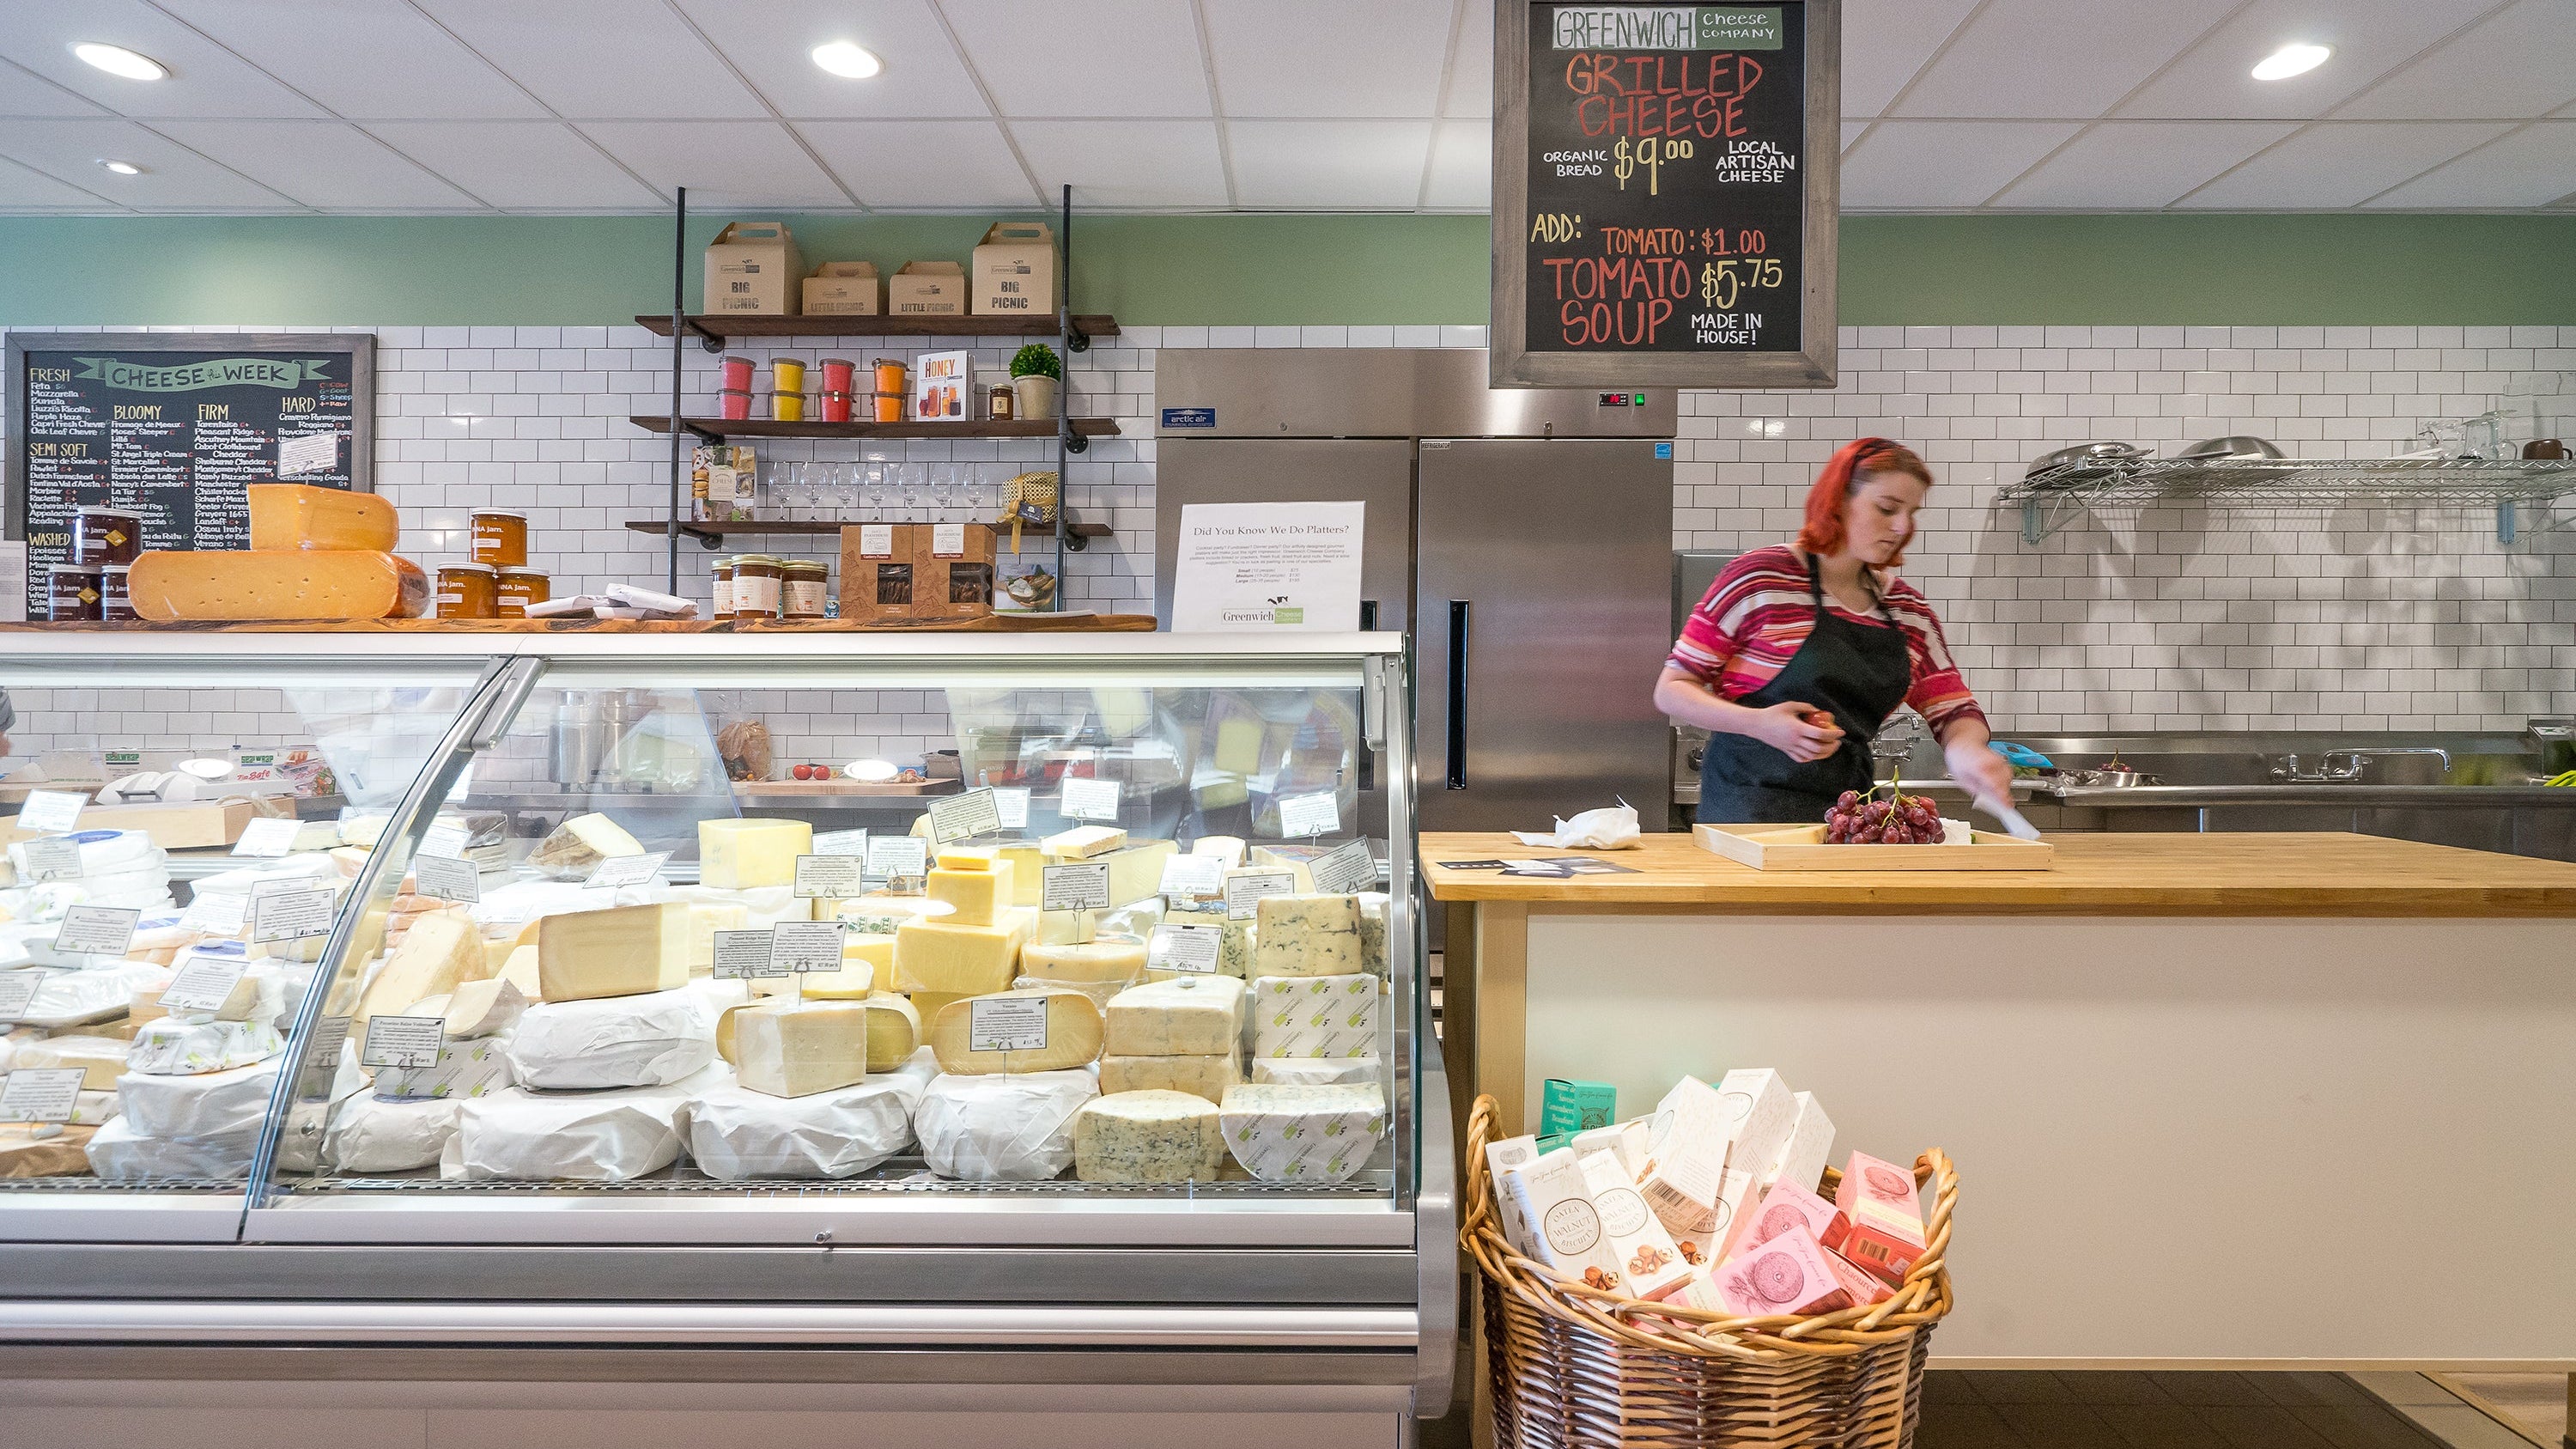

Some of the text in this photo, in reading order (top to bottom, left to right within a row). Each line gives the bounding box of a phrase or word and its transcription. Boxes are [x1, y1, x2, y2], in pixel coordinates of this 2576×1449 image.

[1703, 12, 1769, 27] Cheese
[1555, 10, 1693, 49] GREENWICH
[1702, 27, 1775, 40] COMPANY
[1565, 52, 1763, 96] GRILLED
[1578, 94, 1747, 138] CHEESE
[1728, 140, 1783, 155] LOCAL
[1543, 149, 1608, 163] ORGANIC
[1715, 155, 1795, 170] ARTISAN
[1556, 163, 1602, 177] BREAD
[1613, 136, 1694, 196] $9.00
[1718, 170, 1785, 183] CHEESE
[1530, 213, 1582, 243] ADD:
[1701, 229, 1766, 256] $1.00
[1543, 257, 1691, 301] TOMATO
[1700, 259, 1783, 309] $5.75
[732, 282, 750, 293] BIG
[1001, 282, 1019, 293] BIG
[722, 297, 759, 309] PICNIC
[811, 302, 835, 312] LITTLE
[901, 302, 955, 312] LITTLE PICNIC
[992, 297, 1028, 309] PICNIC
[1560, 297, 1674, 345] SOUP
[1691, 313, 1762, 329] MADE IN
[1696, 329, 1757, 345] HOUSE!
[30, 368, 70, 381] FRESH
[112, 364, 289, 387] CHEESE WEEK
[925, 359, 955, 378] HONEY
[198, 404, 228, 420] FIRM
[283, 397, 316, 412] HARD
[114, 405, 162, 420] BLOOMY
[31, 419, 54, 428] Capri
[30, 443, 88, 457] SEMI SOFT
[1194, 525, 1349, 536] Did You Know We Do Platters?
[28, 533, 70, 546] WASHED
[1223, 610, 1274, 623] Greenwich
[1552, 1215, 1591, 1238] WALNUT
[1560, 1229, 1594, 1247] BISCUITS
[1837, 1261, 1878, 1295] Chaource
